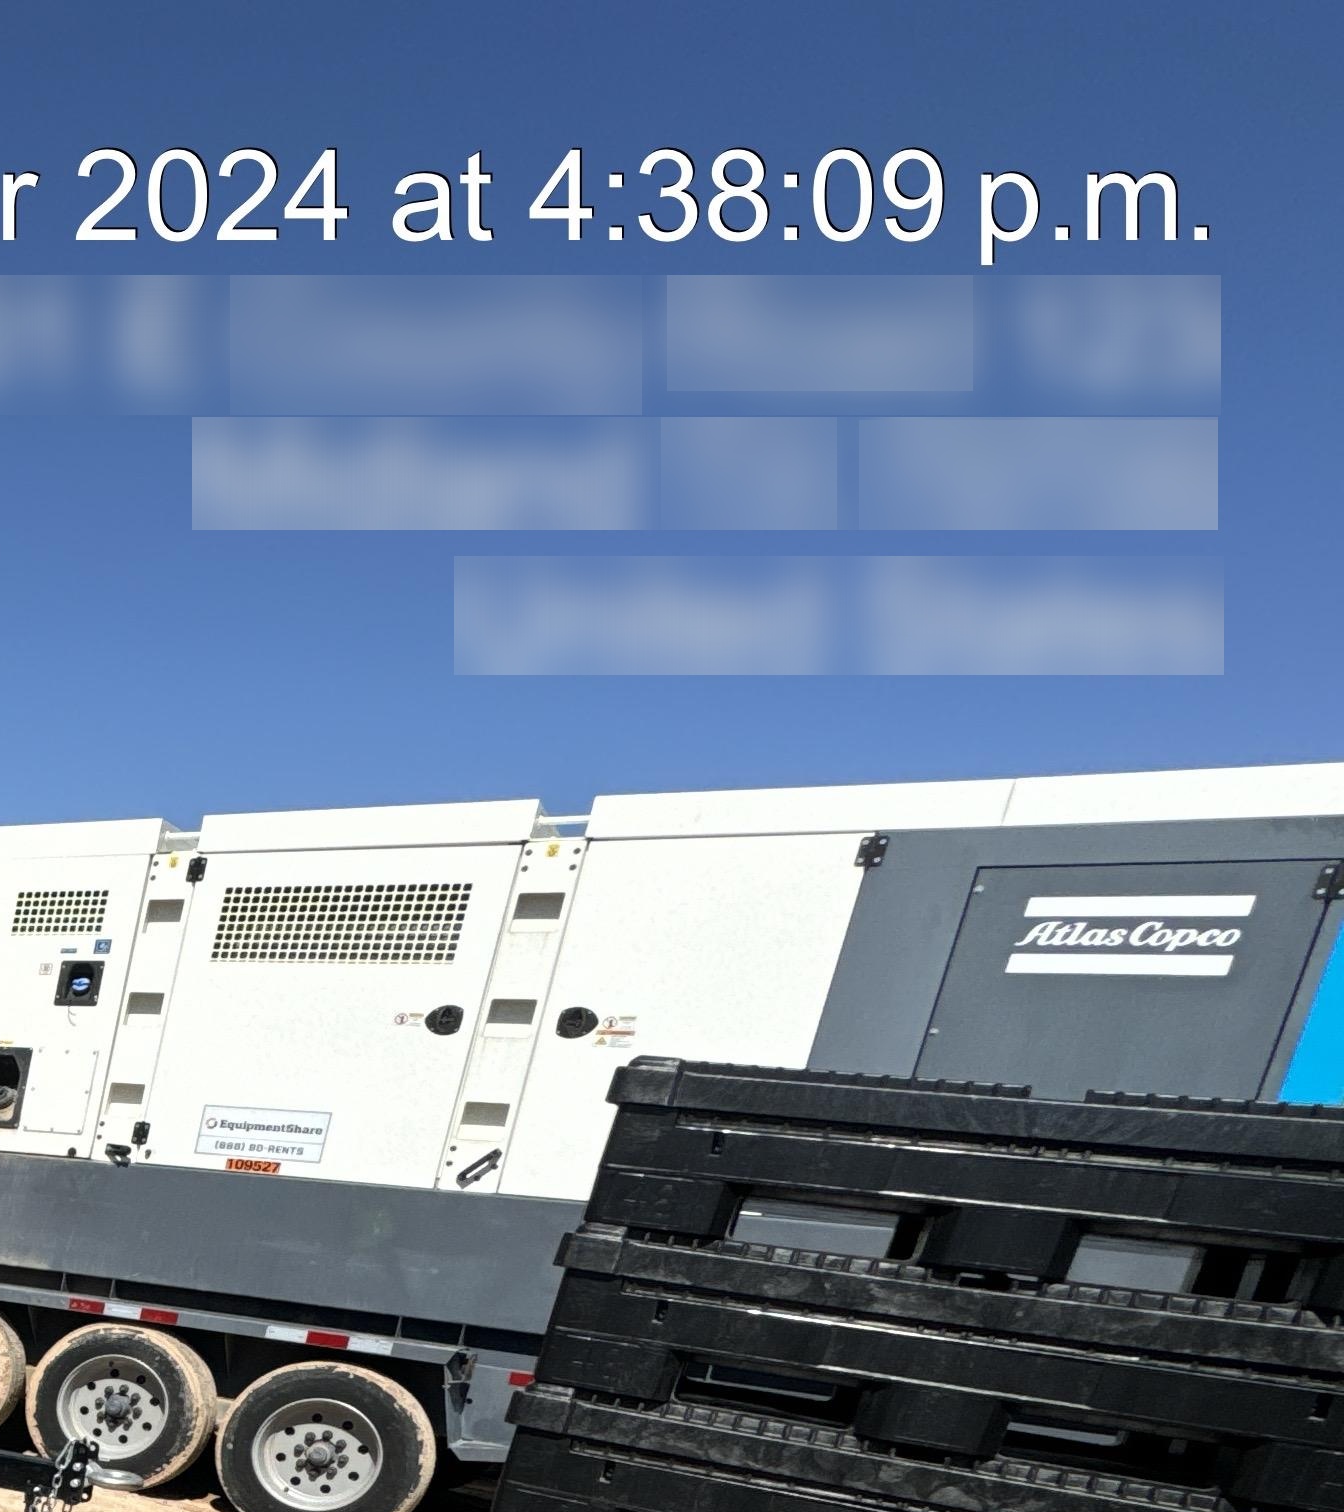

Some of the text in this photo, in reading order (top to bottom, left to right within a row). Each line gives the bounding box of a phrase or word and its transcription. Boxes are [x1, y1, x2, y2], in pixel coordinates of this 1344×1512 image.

[1014, 921, 1242, 952] Atlas Copco
[219, 1120, 323, 1135] EquipmentShare
[227, 1159, 281, 1174] 109527
